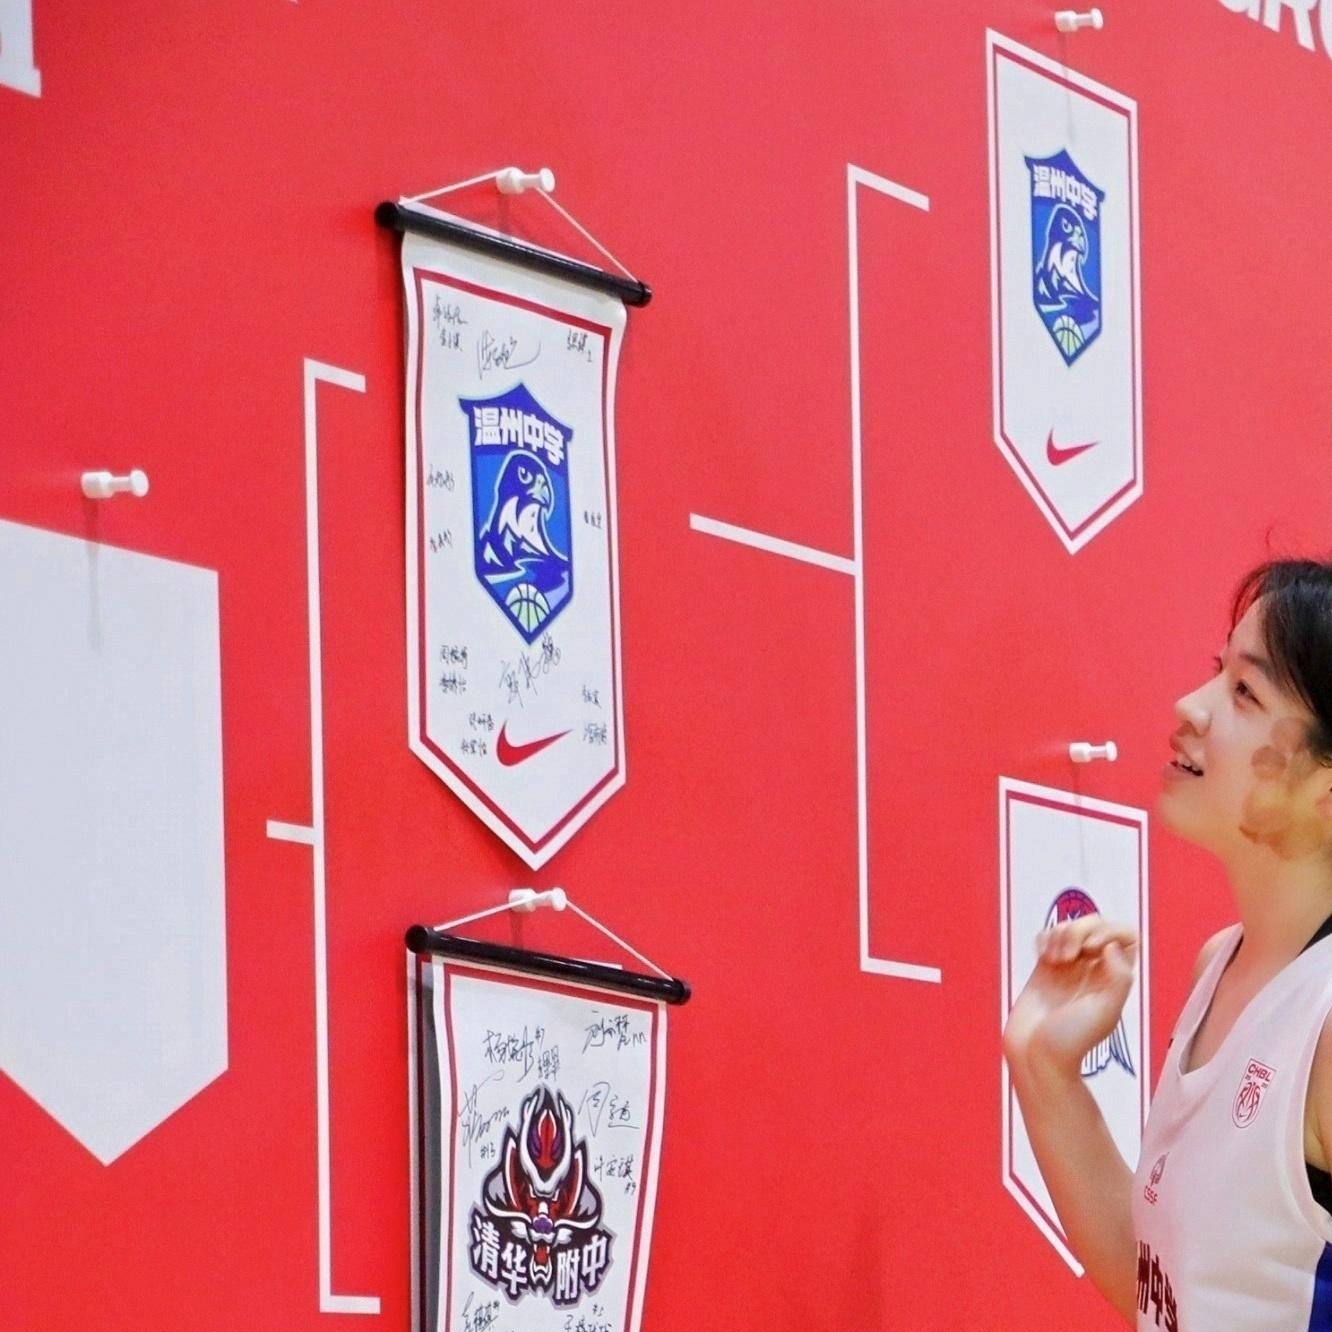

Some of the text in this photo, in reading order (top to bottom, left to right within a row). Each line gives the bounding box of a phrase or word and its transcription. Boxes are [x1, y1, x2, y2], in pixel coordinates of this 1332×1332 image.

[1032, 164, 1097, 221] 温州中学
[473, 406, 565, 467] 温州中学
[1247, 1062, 1271, 1083] CHBL
[474, 1214, 608, 1301] 清华附中
